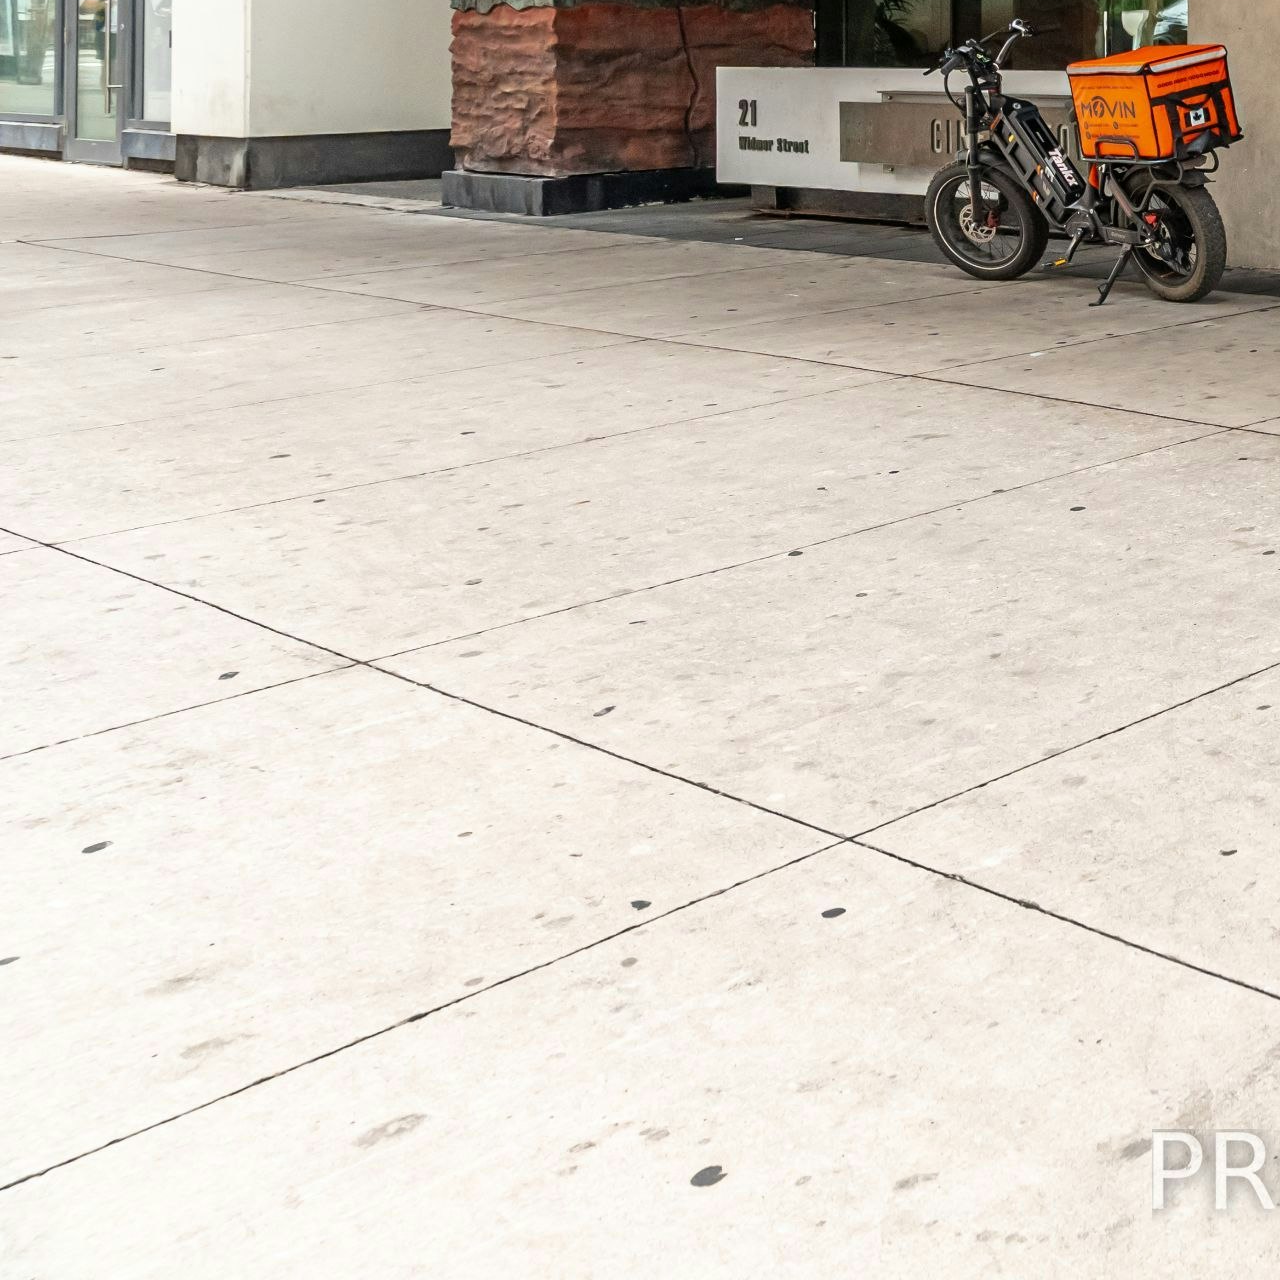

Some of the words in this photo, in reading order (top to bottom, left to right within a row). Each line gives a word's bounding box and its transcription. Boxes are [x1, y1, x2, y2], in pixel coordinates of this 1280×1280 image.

[738, 99, 757, 127] 21
[1081, 96, 1136, 118] MOVIN
[738, 136, 773, 151] Widmer
[776, 138, 809, 154] Street
